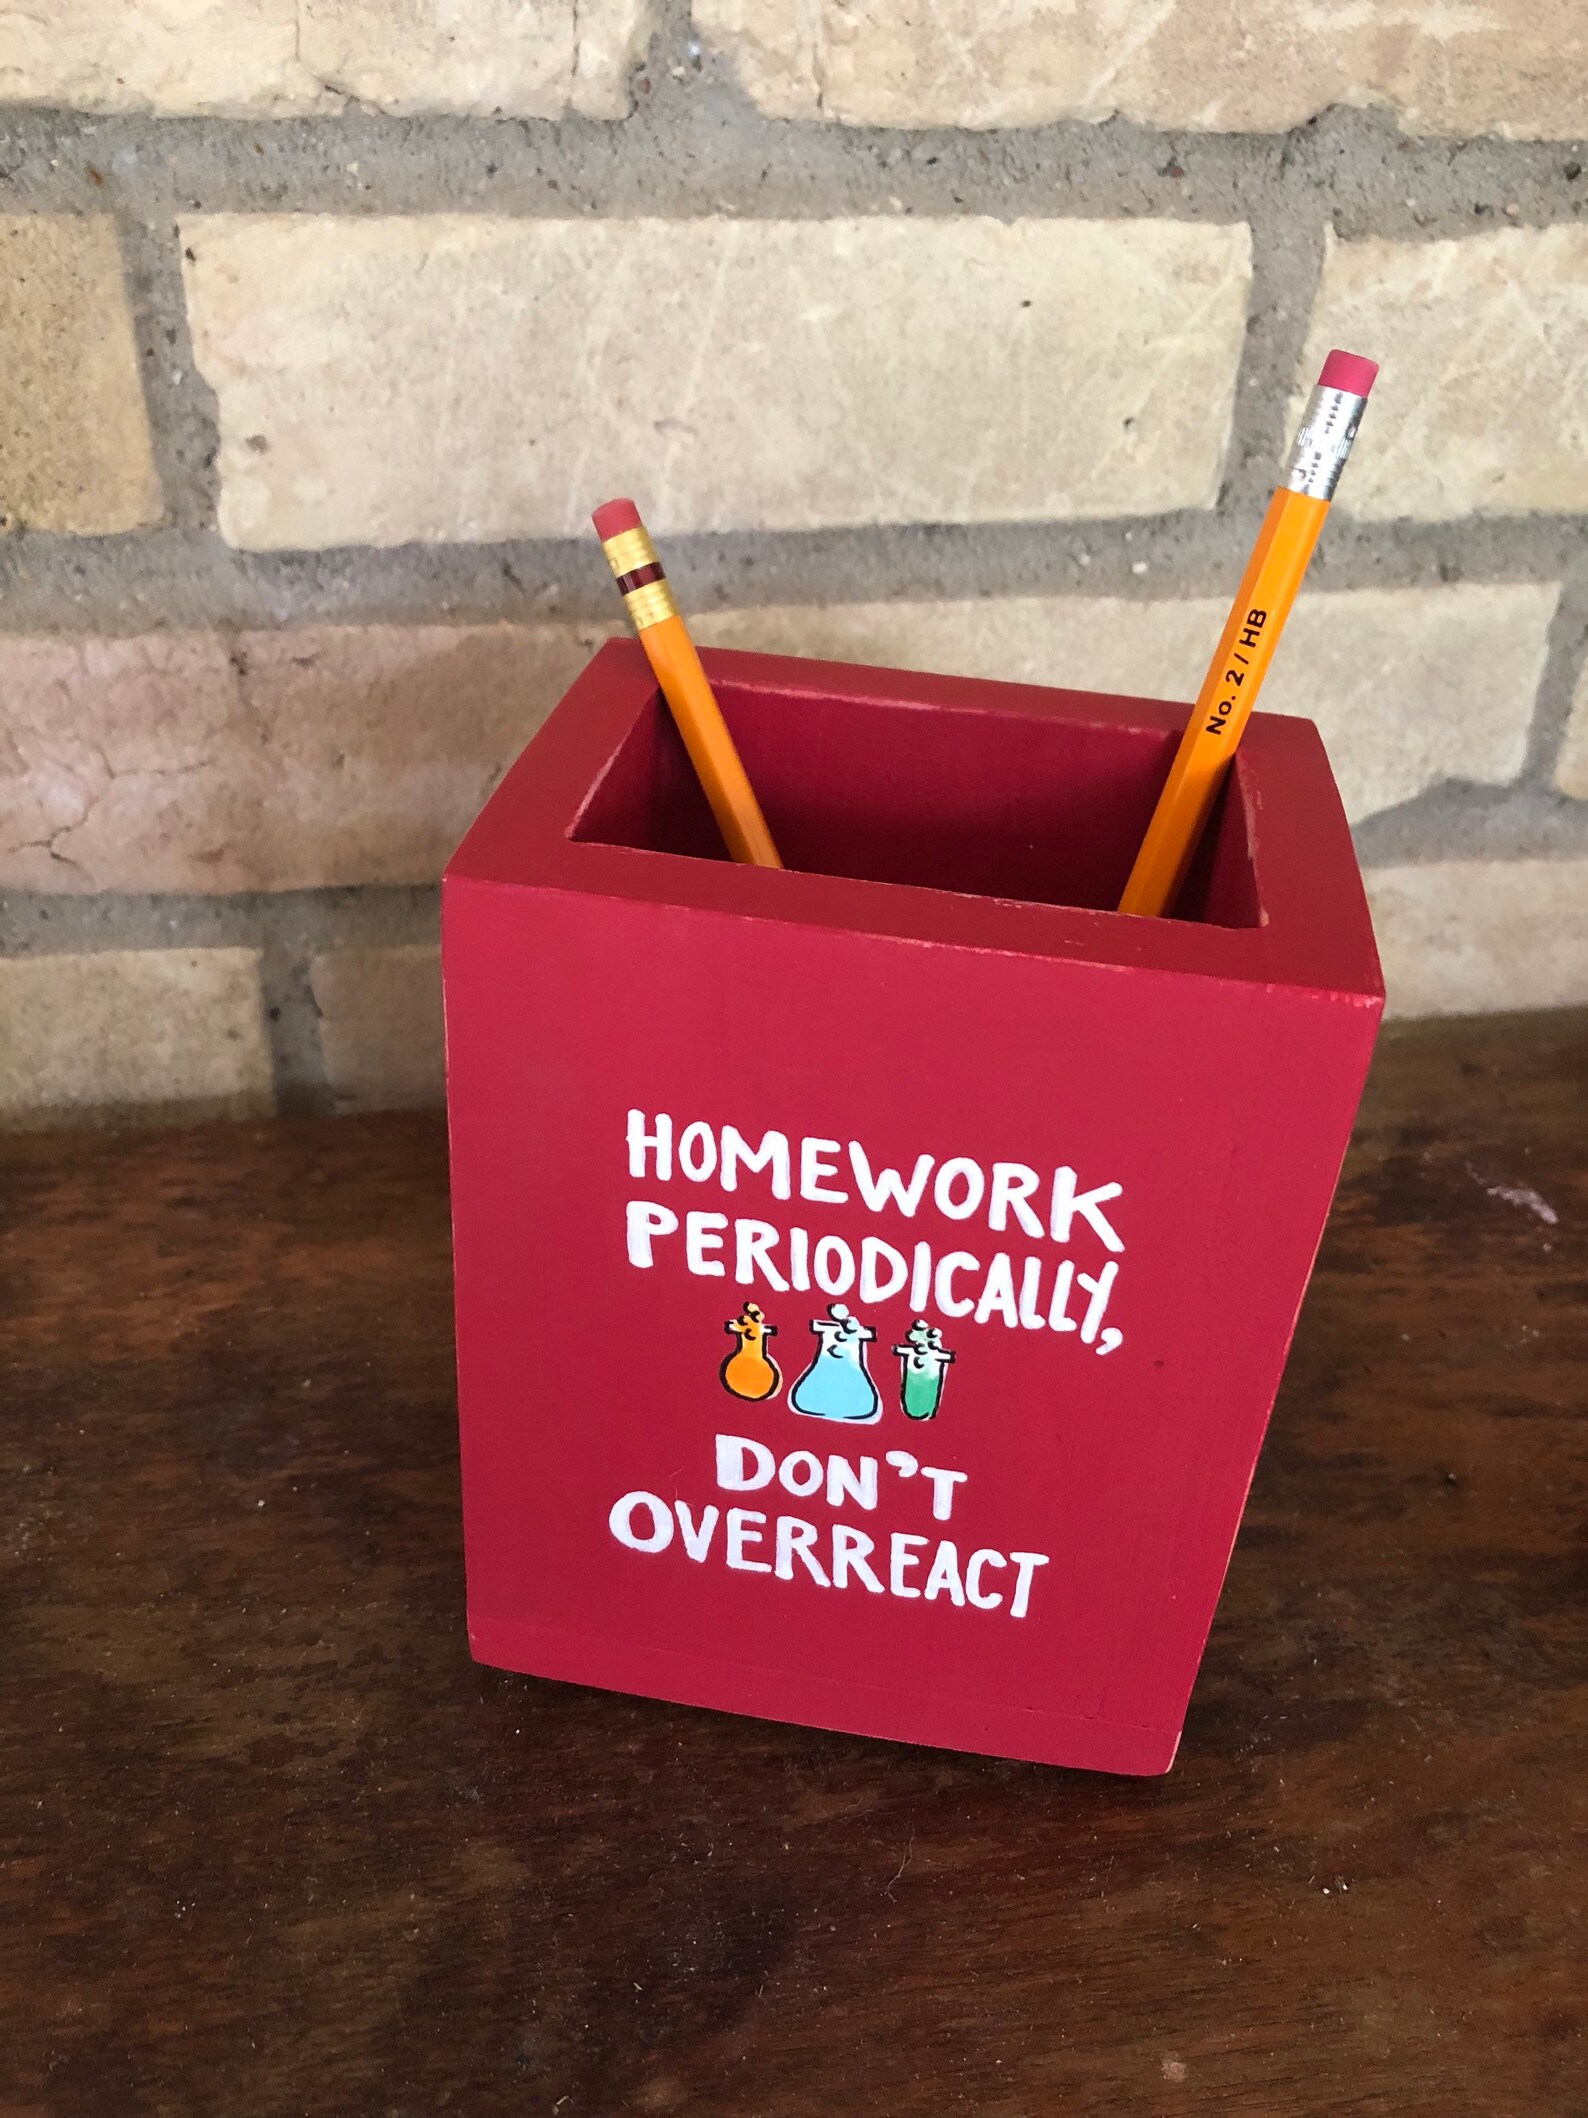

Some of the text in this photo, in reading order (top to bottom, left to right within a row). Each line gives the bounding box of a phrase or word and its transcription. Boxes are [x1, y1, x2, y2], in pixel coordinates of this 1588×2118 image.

[1205, 695, 1236, 735] No.
[1225, 669, 1245, 687] 2
[1238, 608, 1268, 648] HB
[625, 1108, 1126, 1253] HOMEWORK
[625, 1200, 1124, 1356] PERIODICALLY,
[715, 1433, 968, 1522] DON'T
[608, 1490, 1050, 1619] OVERREACT
